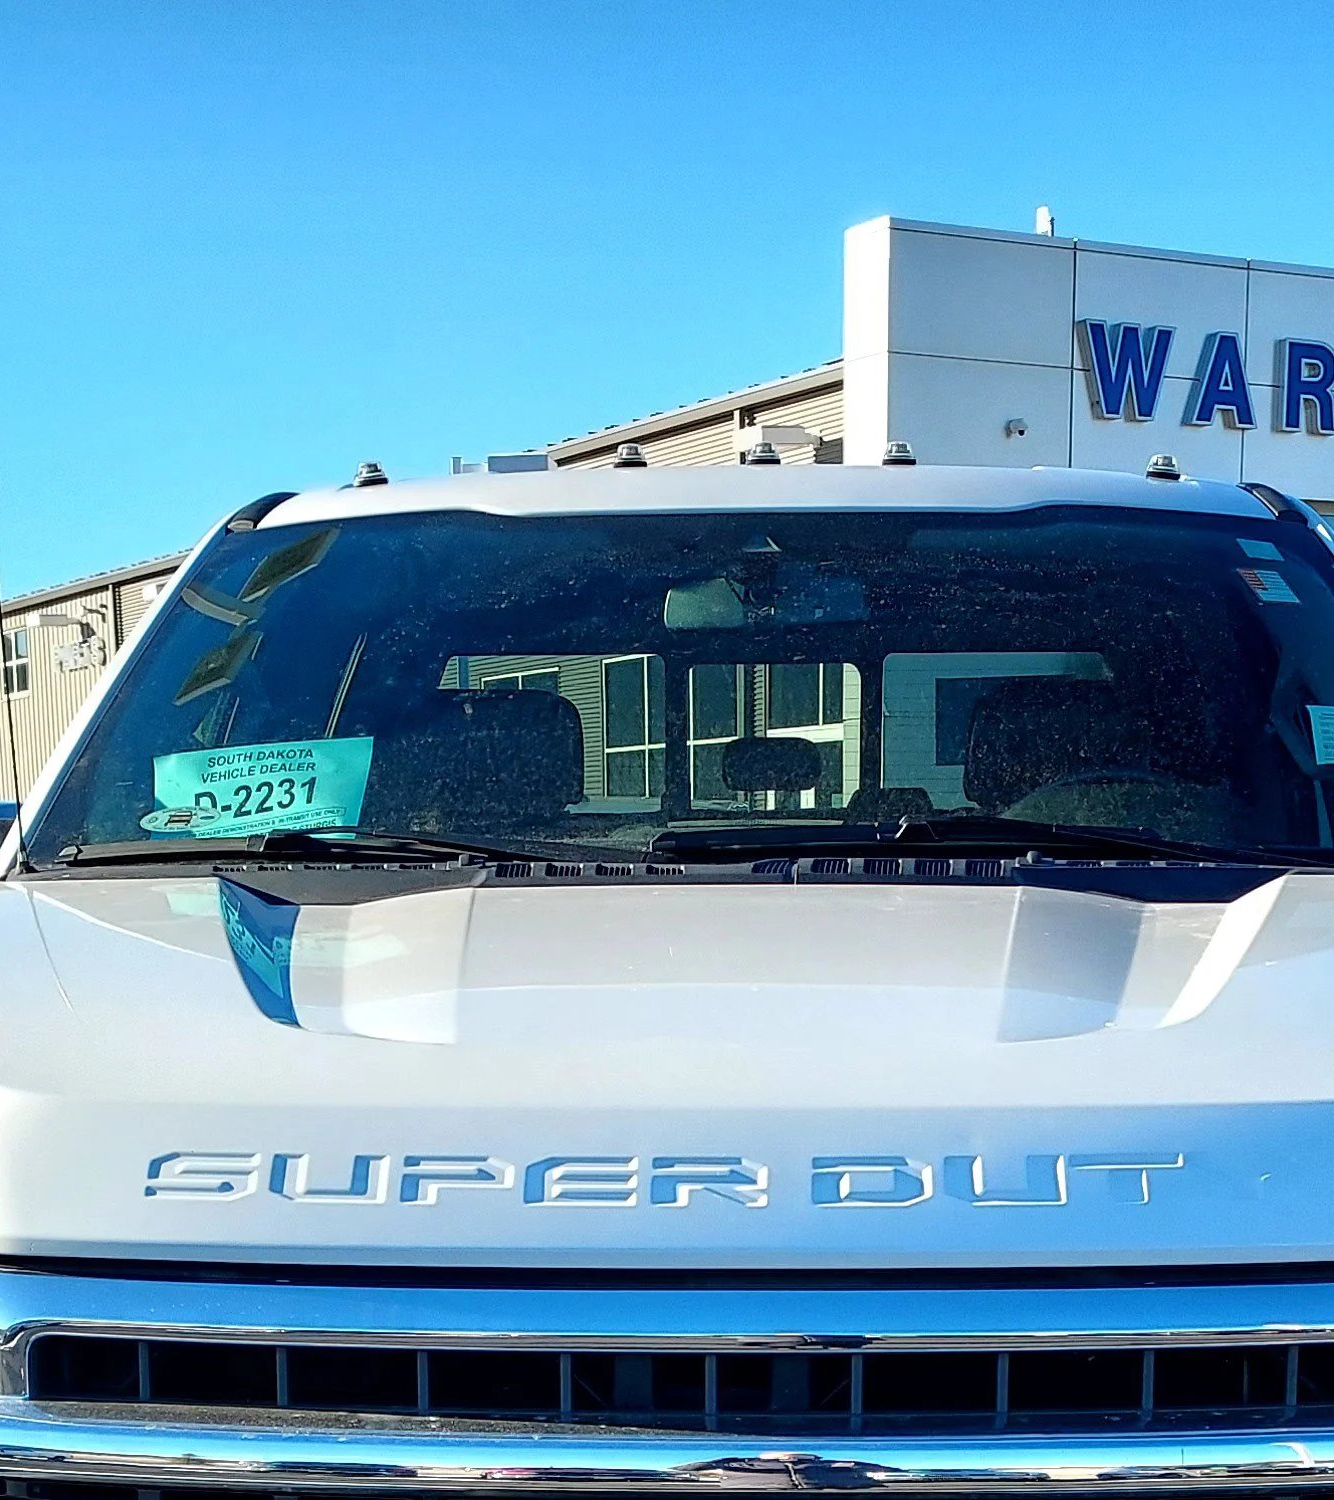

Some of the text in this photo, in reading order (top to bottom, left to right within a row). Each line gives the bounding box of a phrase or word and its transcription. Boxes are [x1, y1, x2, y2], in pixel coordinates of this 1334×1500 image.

[201, 761, 316, 784] VEHICLE DEALER
[207, 748, 314, 768] SOUTH DAKOTA
[194, 776, 319, 819] D-2231
[144, 1151, 1271, 1208] SUPER DUT
